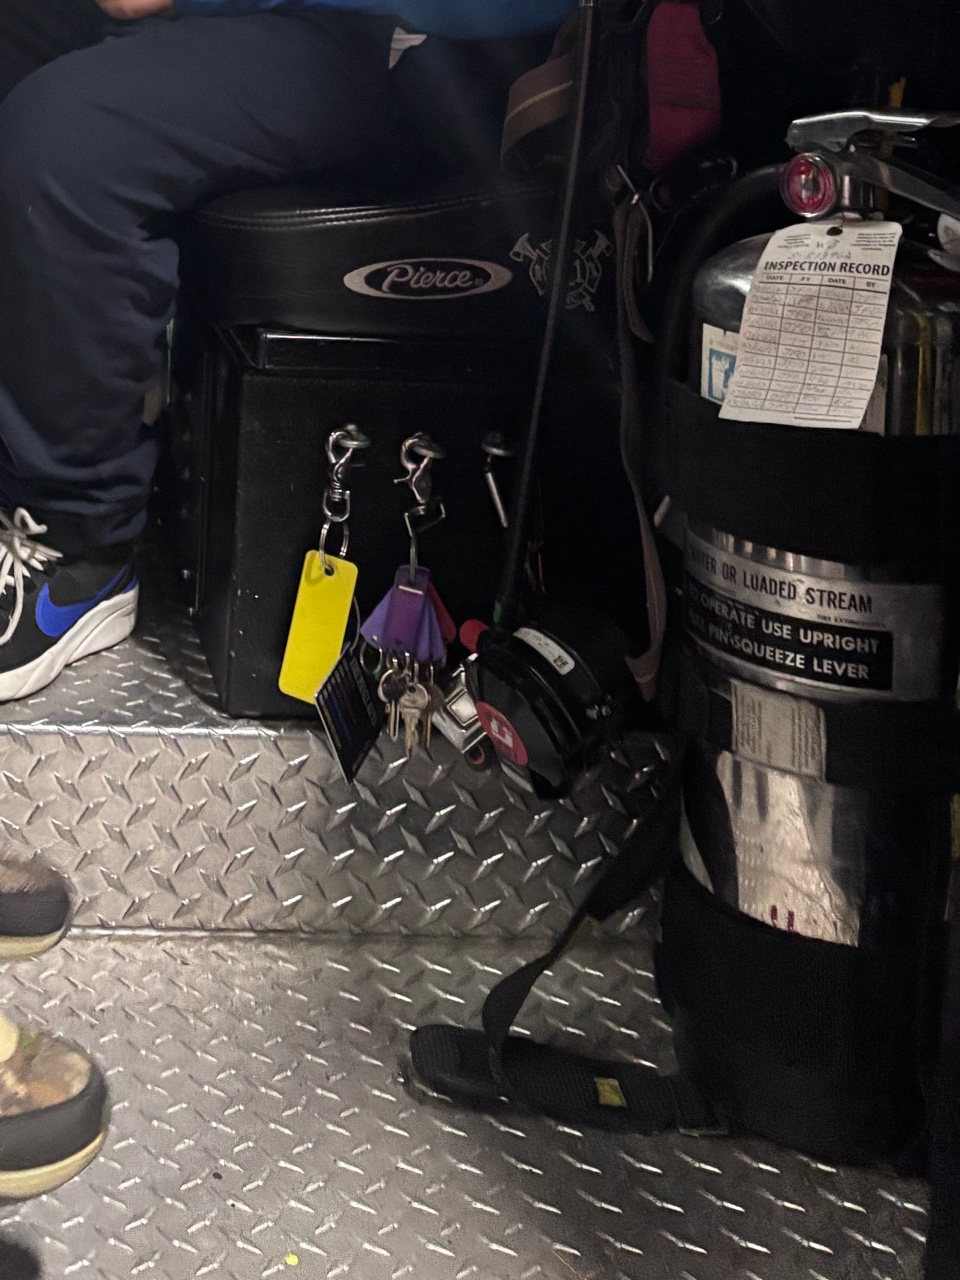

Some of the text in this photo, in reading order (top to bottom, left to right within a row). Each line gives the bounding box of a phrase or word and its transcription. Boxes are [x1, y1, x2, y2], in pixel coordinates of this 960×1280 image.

[381, 264, 474, 293] Pierce
[763, 260, 890, 277] INSPECTION RECORD
[828, 277, 846, 285] DATE
[722, 563, 737, 585] OR
[805, 587, 873, 614] STREAM
[700, 590, 755, 630] OPERATE
[761, 619, 792, 640] USE
[799, 628, 880, 655] UPRIGHT
[812, 656, 870, 680] LEVER
